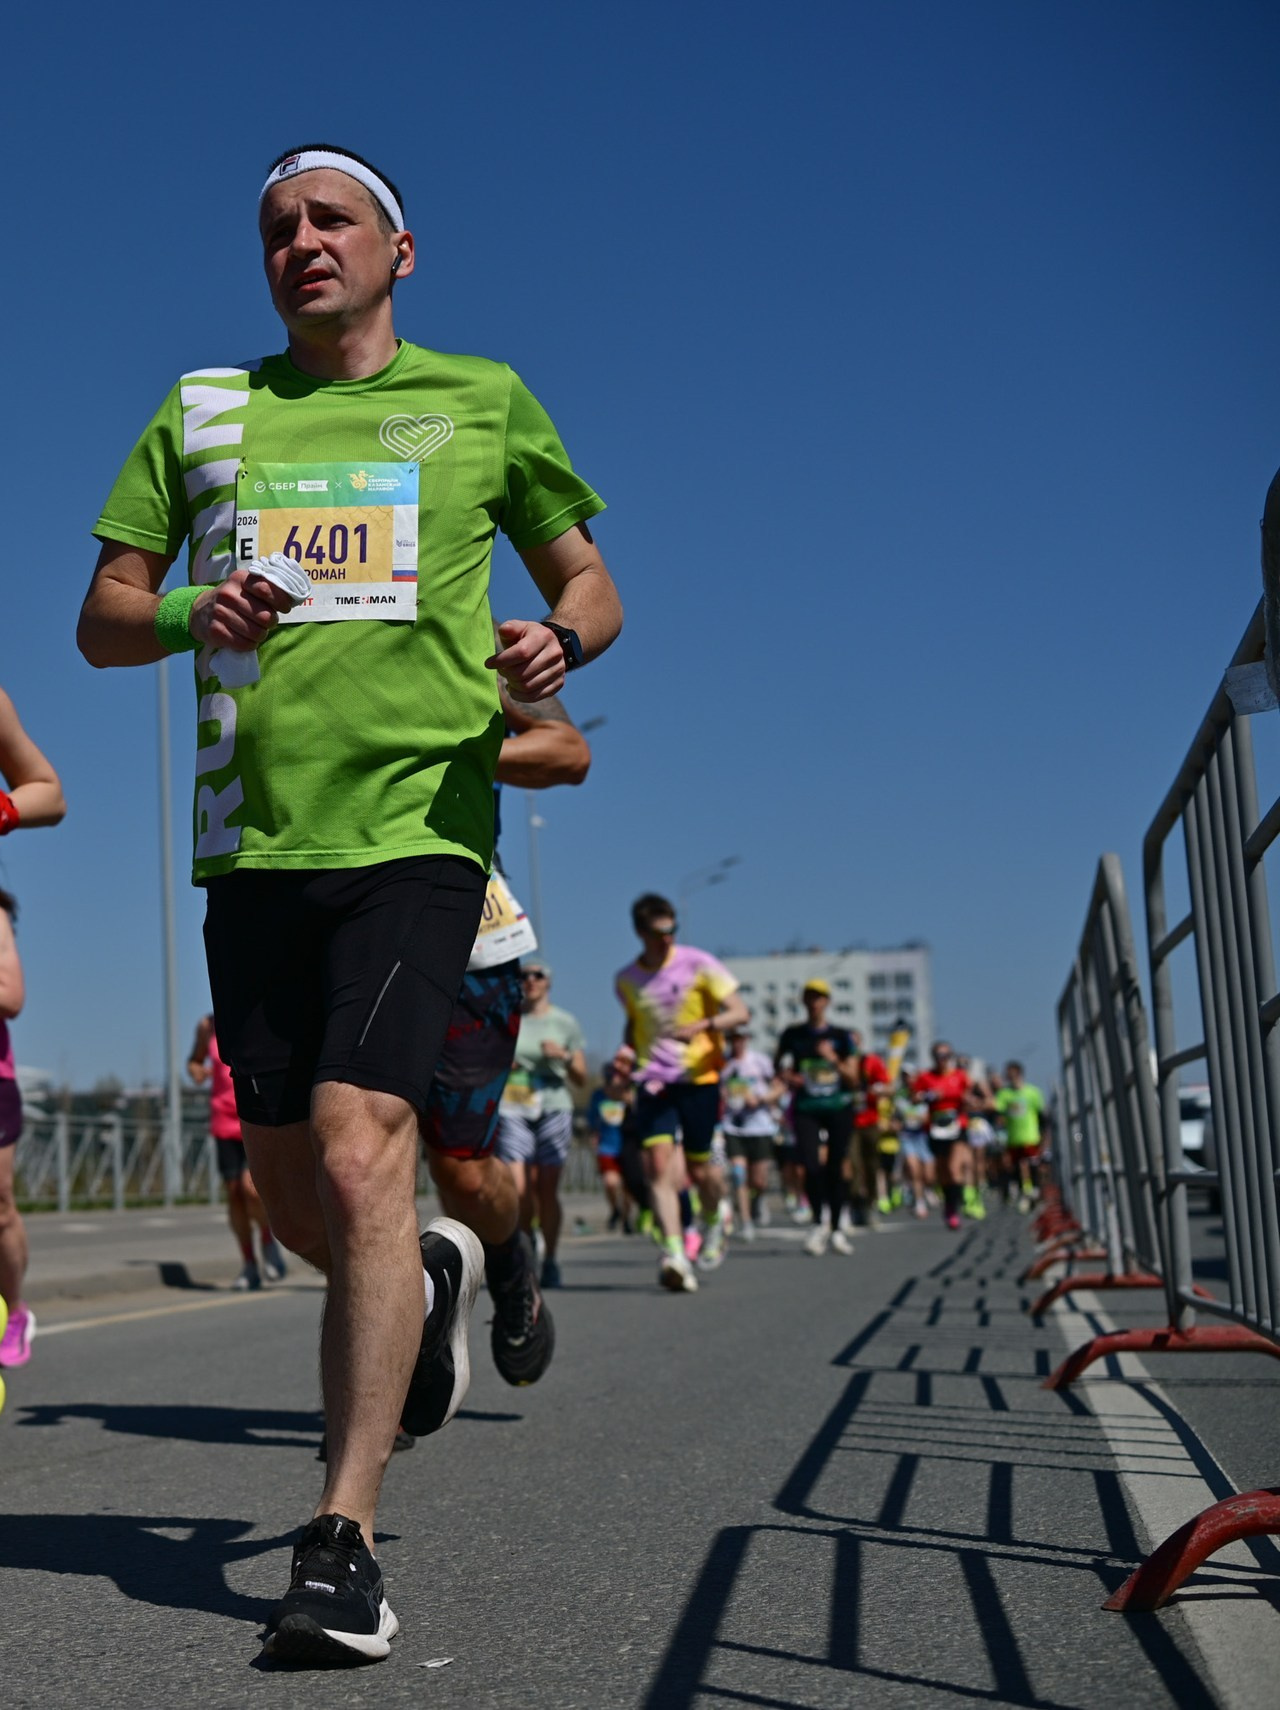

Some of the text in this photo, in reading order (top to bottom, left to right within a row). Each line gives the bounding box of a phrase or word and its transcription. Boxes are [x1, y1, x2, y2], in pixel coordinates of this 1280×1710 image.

[269, 482, 296, 491] СБЕР
[237, 516, 258, 526] 2026
[240, 537, 254, 561] E
[283, 523, 367, 565] 6401
[304, 568, 346, 582] РОМАН
[180, 367, 250, 863] RUNIN
